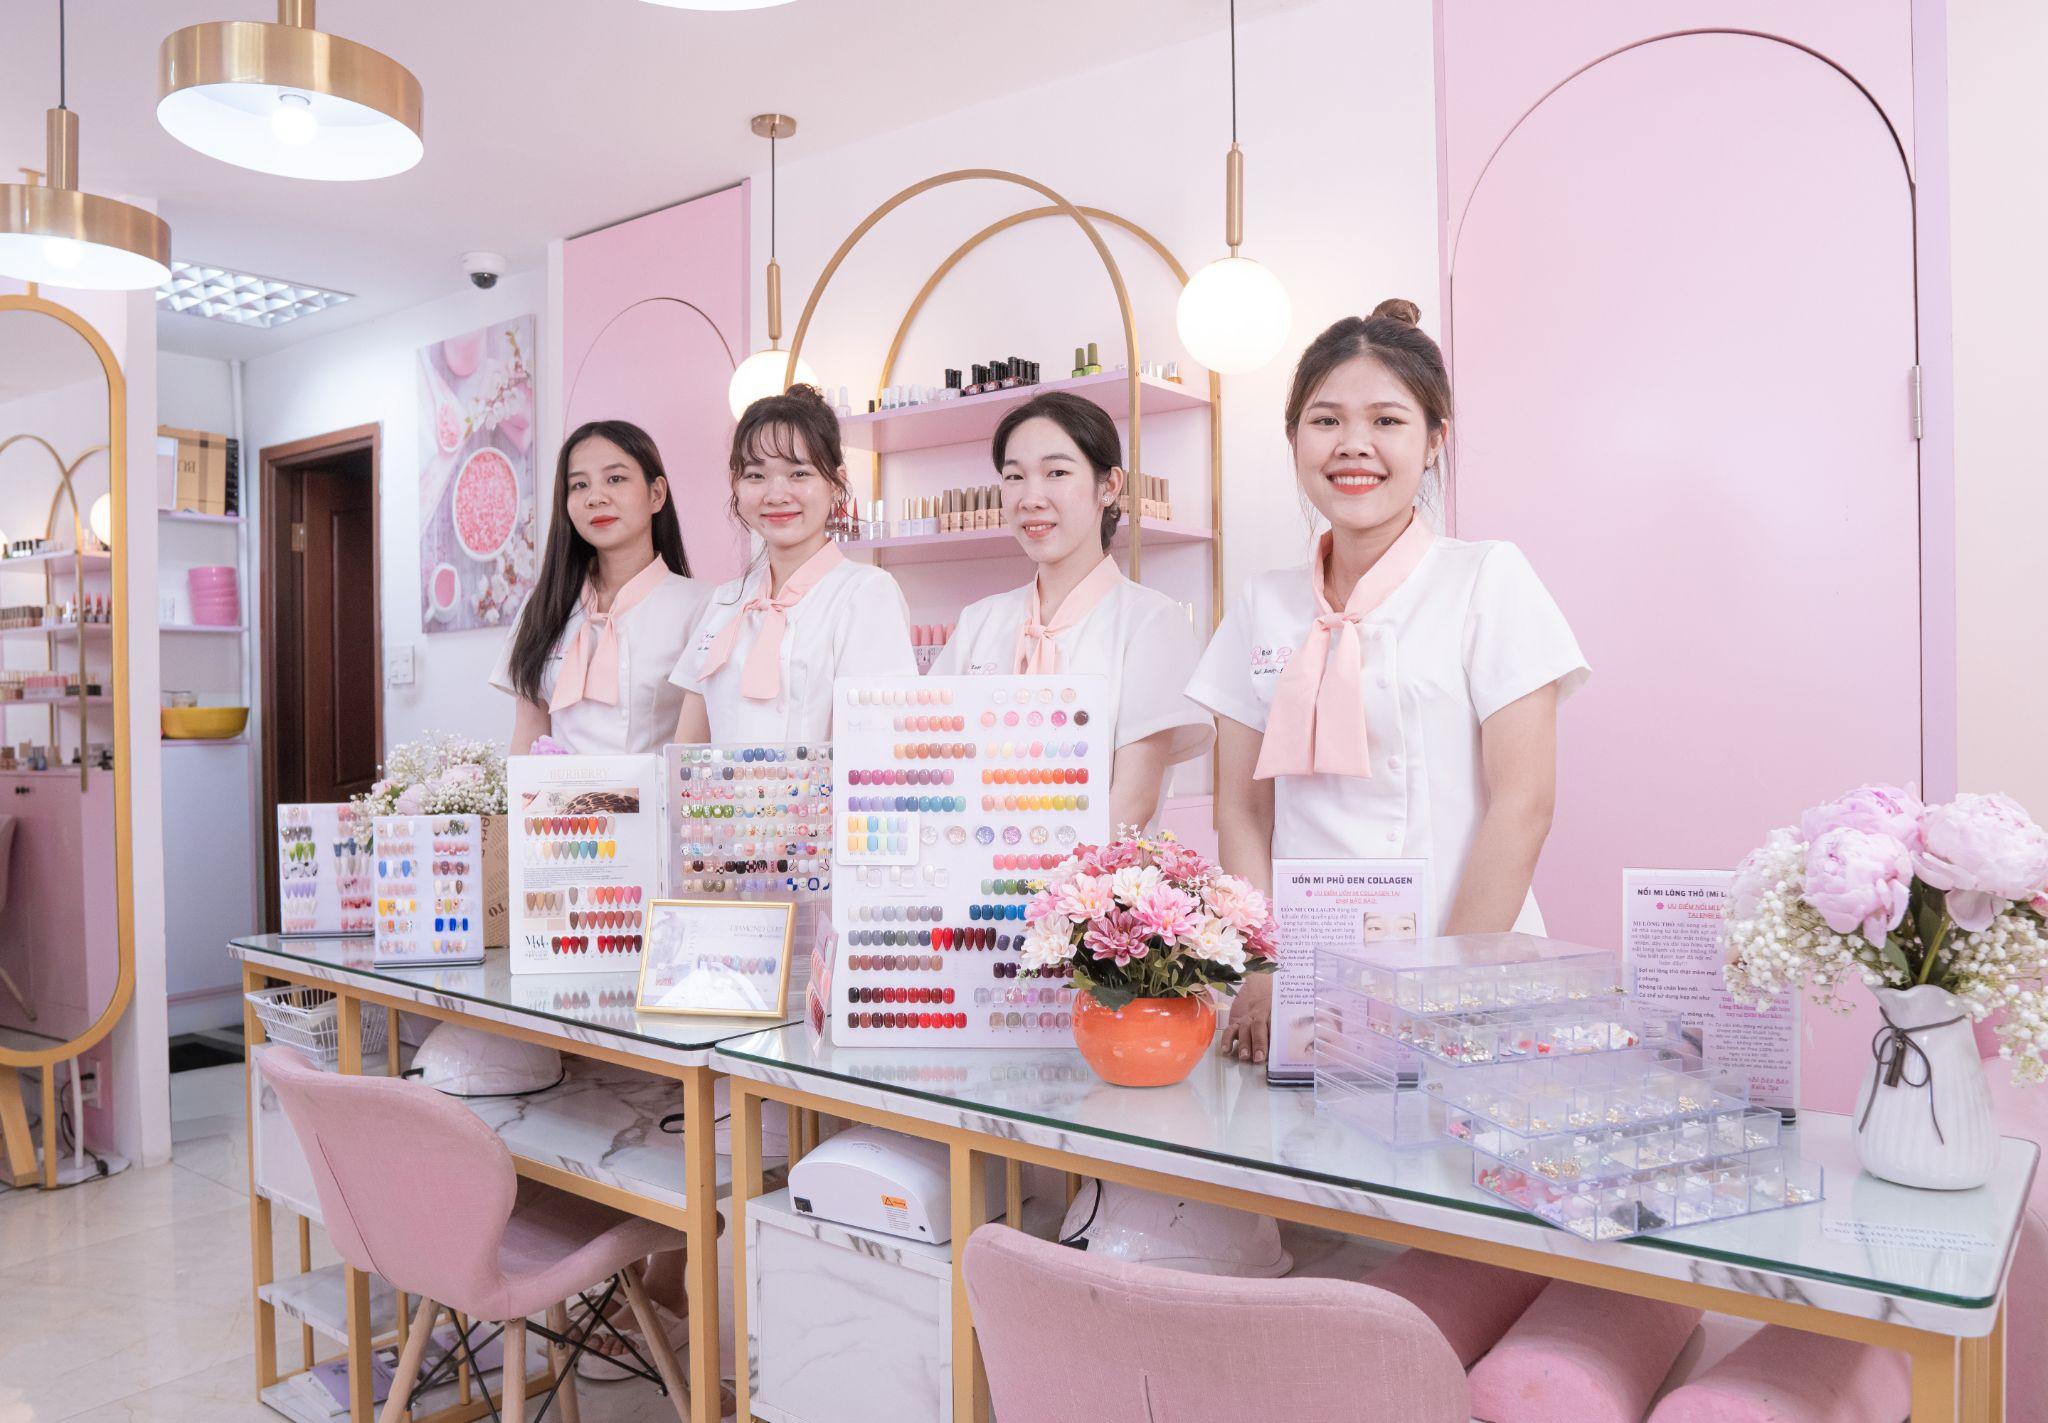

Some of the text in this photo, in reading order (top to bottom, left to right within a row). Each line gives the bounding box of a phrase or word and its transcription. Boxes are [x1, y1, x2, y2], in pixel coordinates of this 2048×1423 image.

[1292, 874, 1310, 884] UỐN
[1326, 874, 1344, 884] PHỦ
[1638, 887, 1651, 895] NỐI
[1666, 888, 1686, 896] LÔNG
[1688, 888, 1704, 897] THỎ
